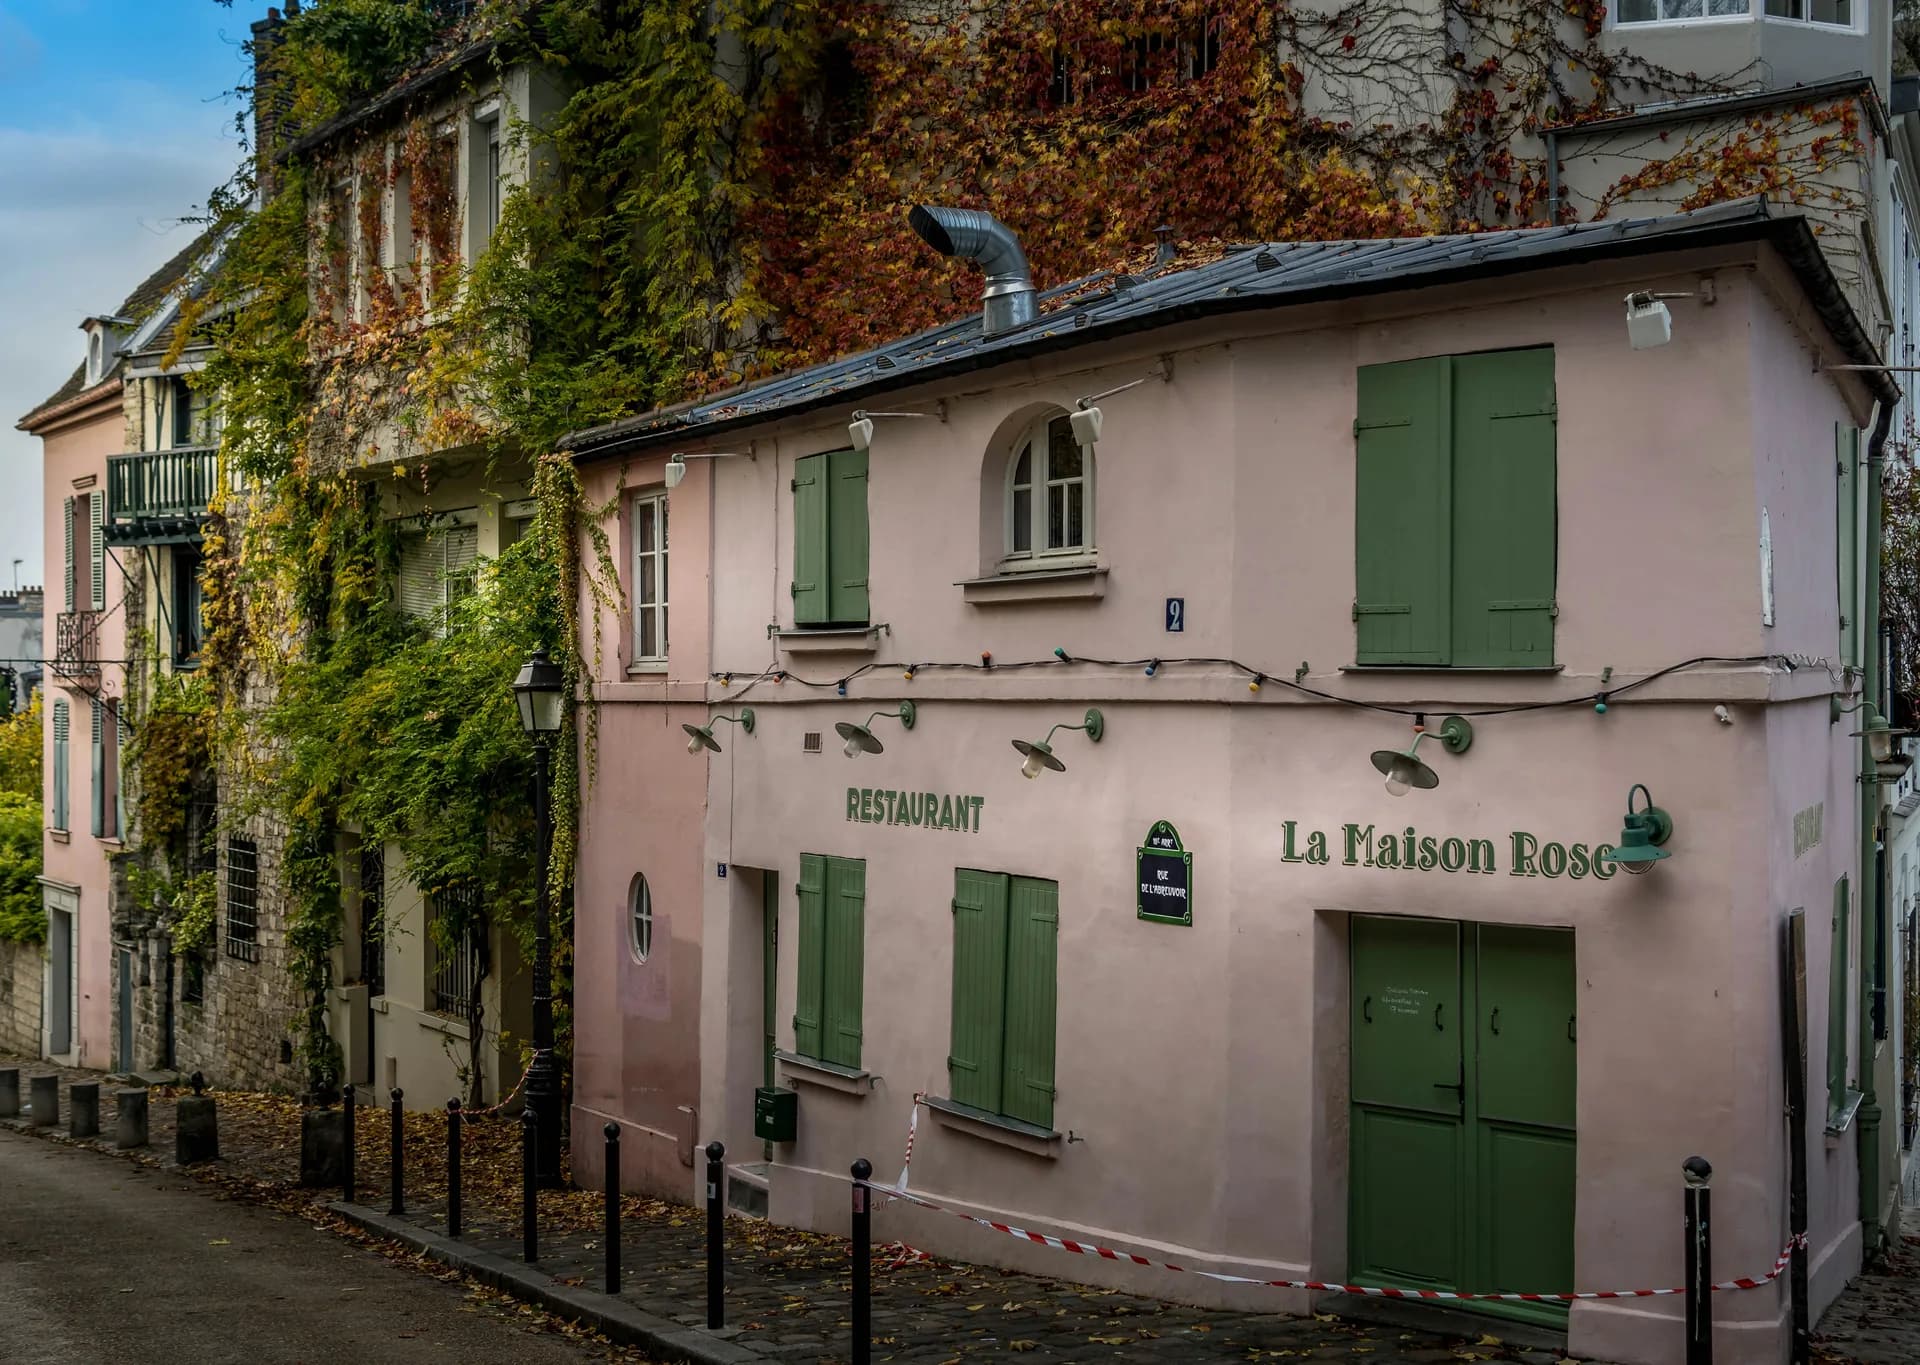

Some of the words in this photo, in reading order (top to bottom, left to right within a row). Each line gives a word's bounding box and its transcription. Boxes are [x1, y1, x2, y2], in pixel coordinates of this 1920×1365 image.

[1169, 600, 1180, 631] 2
[846, 787, 985, 834] RESTAURANT
[1281, 820, 1330, 864] La
[1342, 823, 1497, 874] Maison
[1509, 831, 1617, 880] Rose
[1156, 870, 1169, 880] RUE
[1141, 883, 1149, 894] DE
[1149, 884, 1187, 899] L'ABREUVOIR
